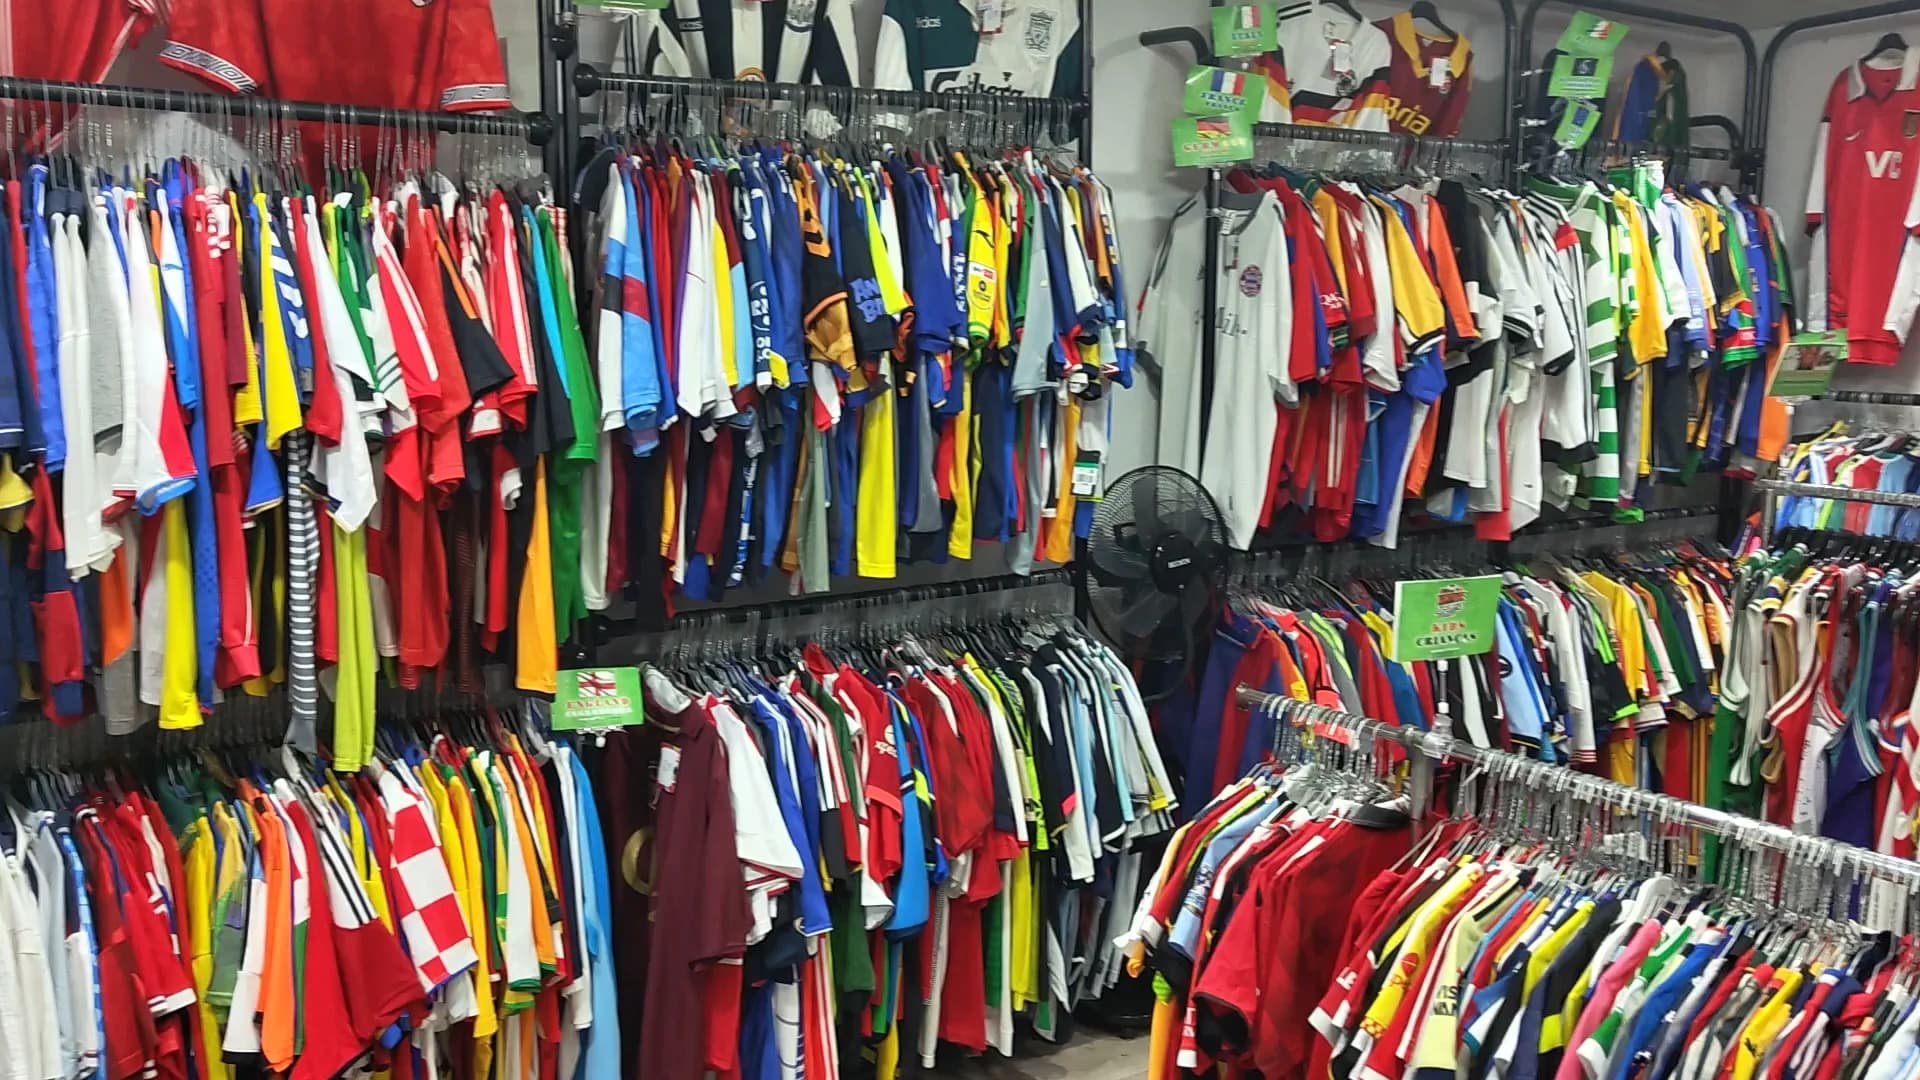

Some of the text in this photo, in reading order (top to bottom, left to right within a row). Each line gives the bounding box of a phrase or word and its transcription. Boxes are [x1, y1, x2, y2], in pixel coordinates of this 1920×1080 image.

[1183, 137, 1248, 152] GERM
[1431, 622, 1465, 633] KIDS
[567, 697, 630, 709] ENGLAND
